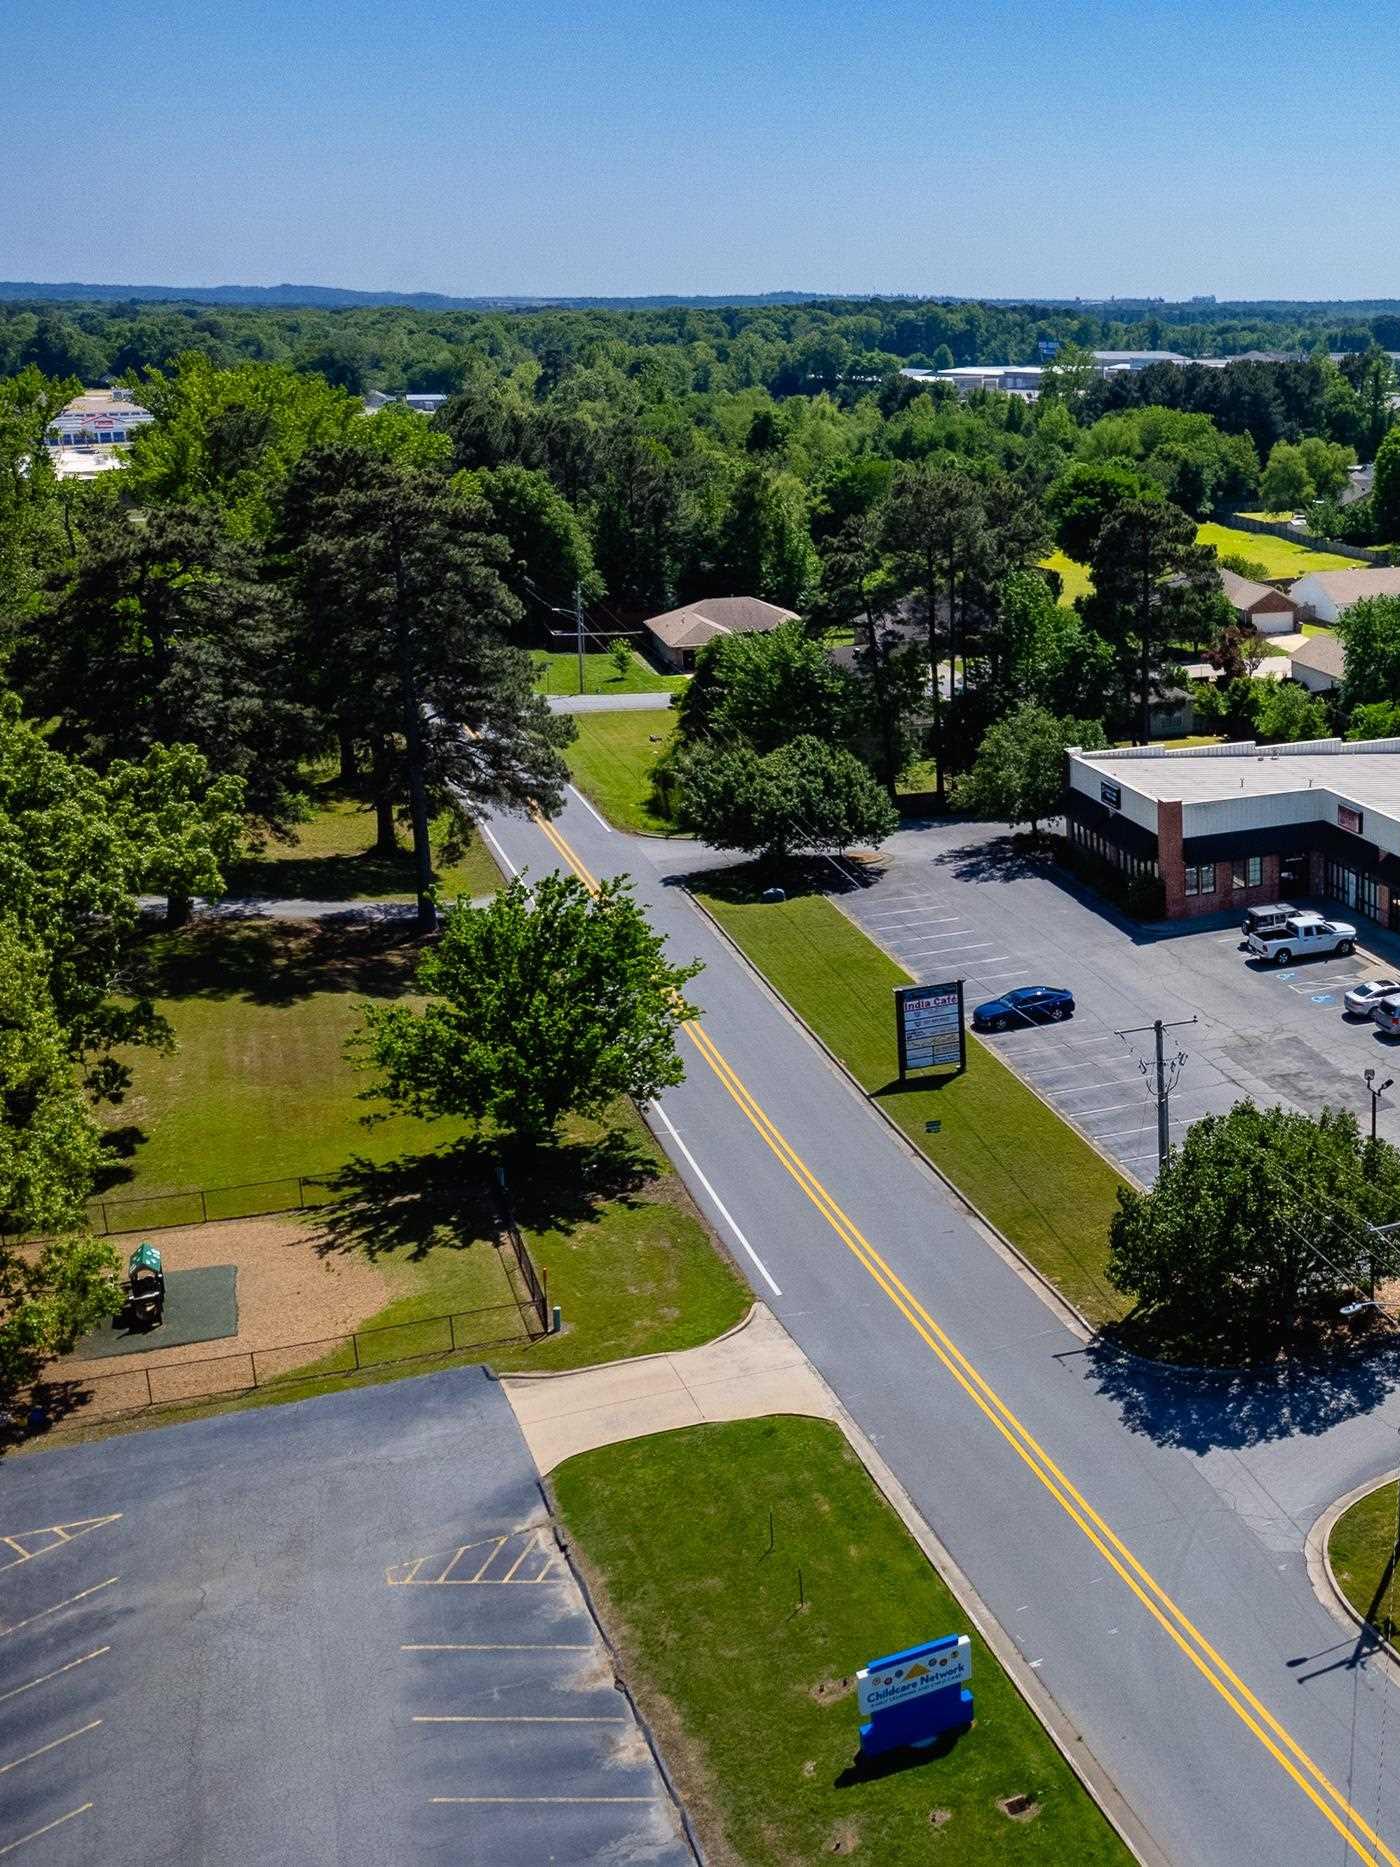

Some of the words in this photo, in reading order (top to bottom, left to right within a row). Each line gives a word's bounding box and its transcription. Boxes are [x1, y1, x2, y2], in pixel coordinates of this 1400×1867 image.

[905, 1000, 931, 1011] India
[866, 1681, 919, 1703] Childcare
[920, 1663, 965, 1685] Network
